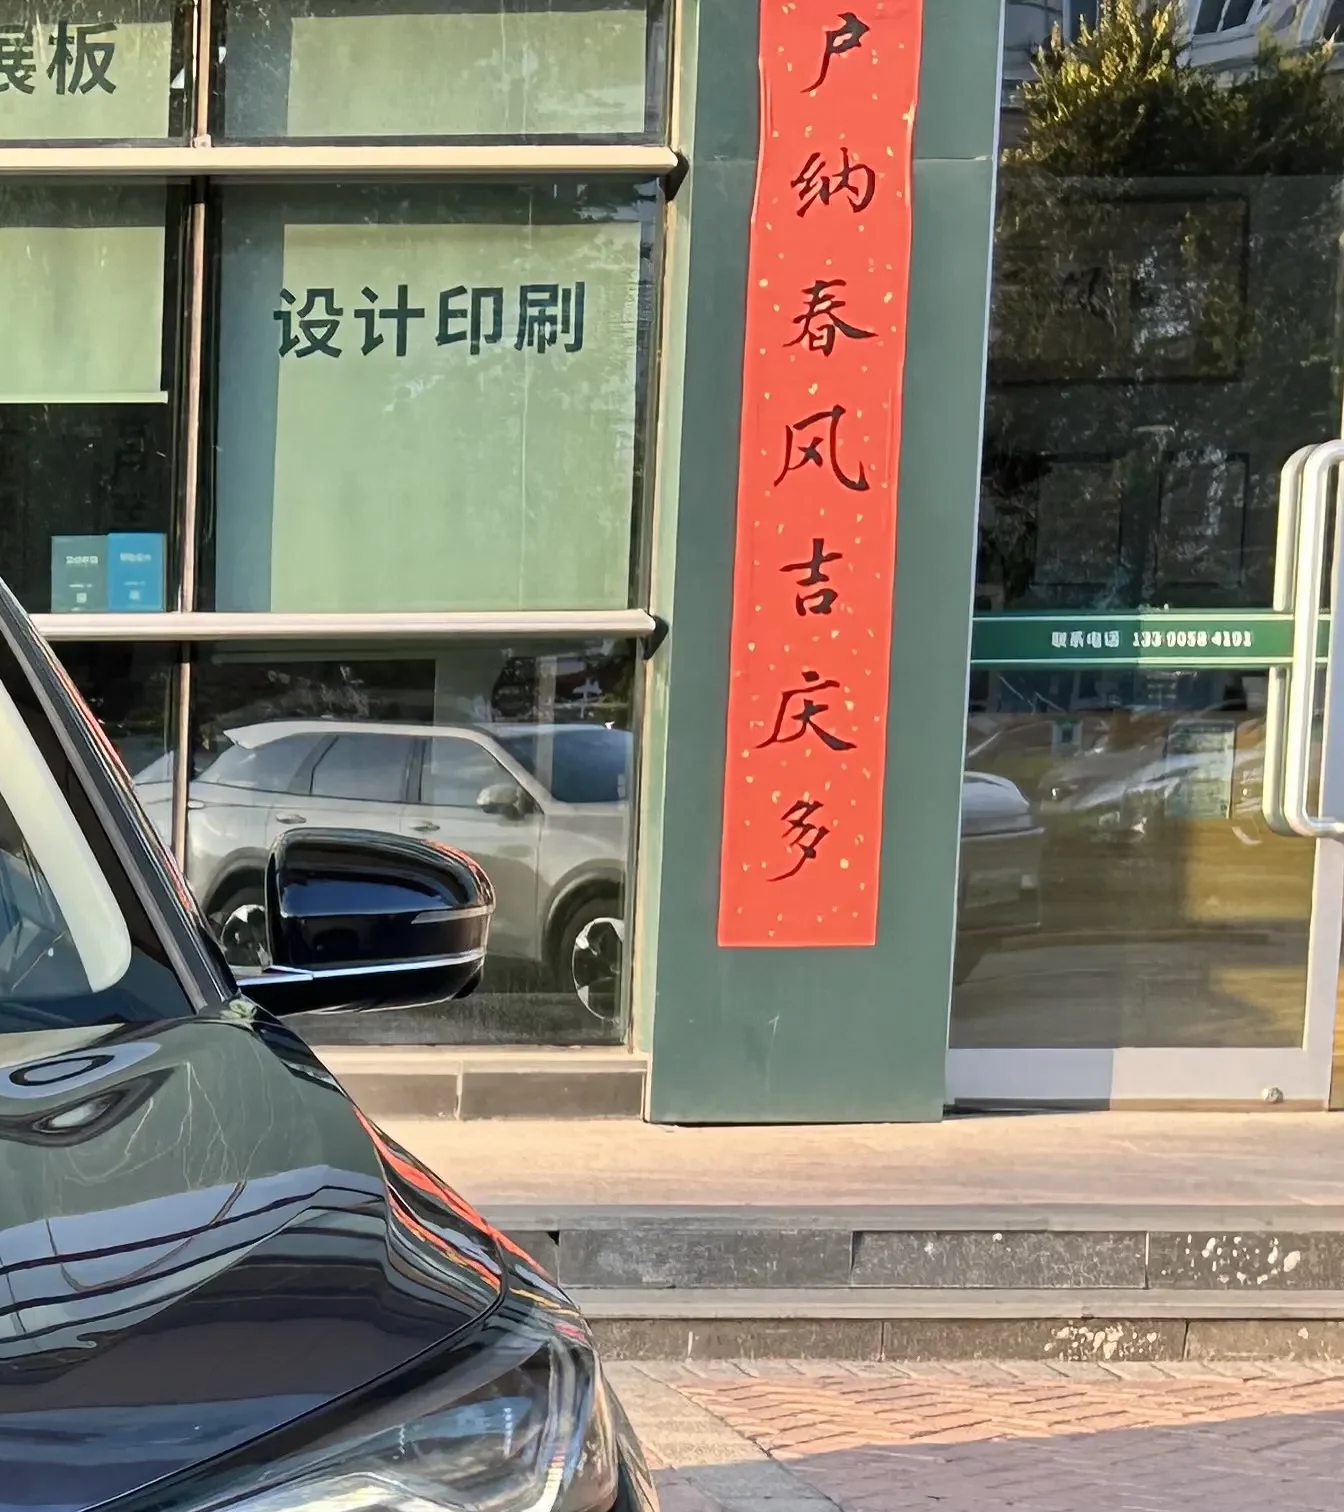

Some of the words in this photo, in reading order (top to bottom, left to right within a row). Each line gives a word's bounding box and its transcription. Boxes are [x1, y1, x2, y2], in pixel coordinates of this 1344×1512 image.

[272, 281, 586, 360] 设计印刷
[756, 12, 879, 882] 户纳春风吉庆多
